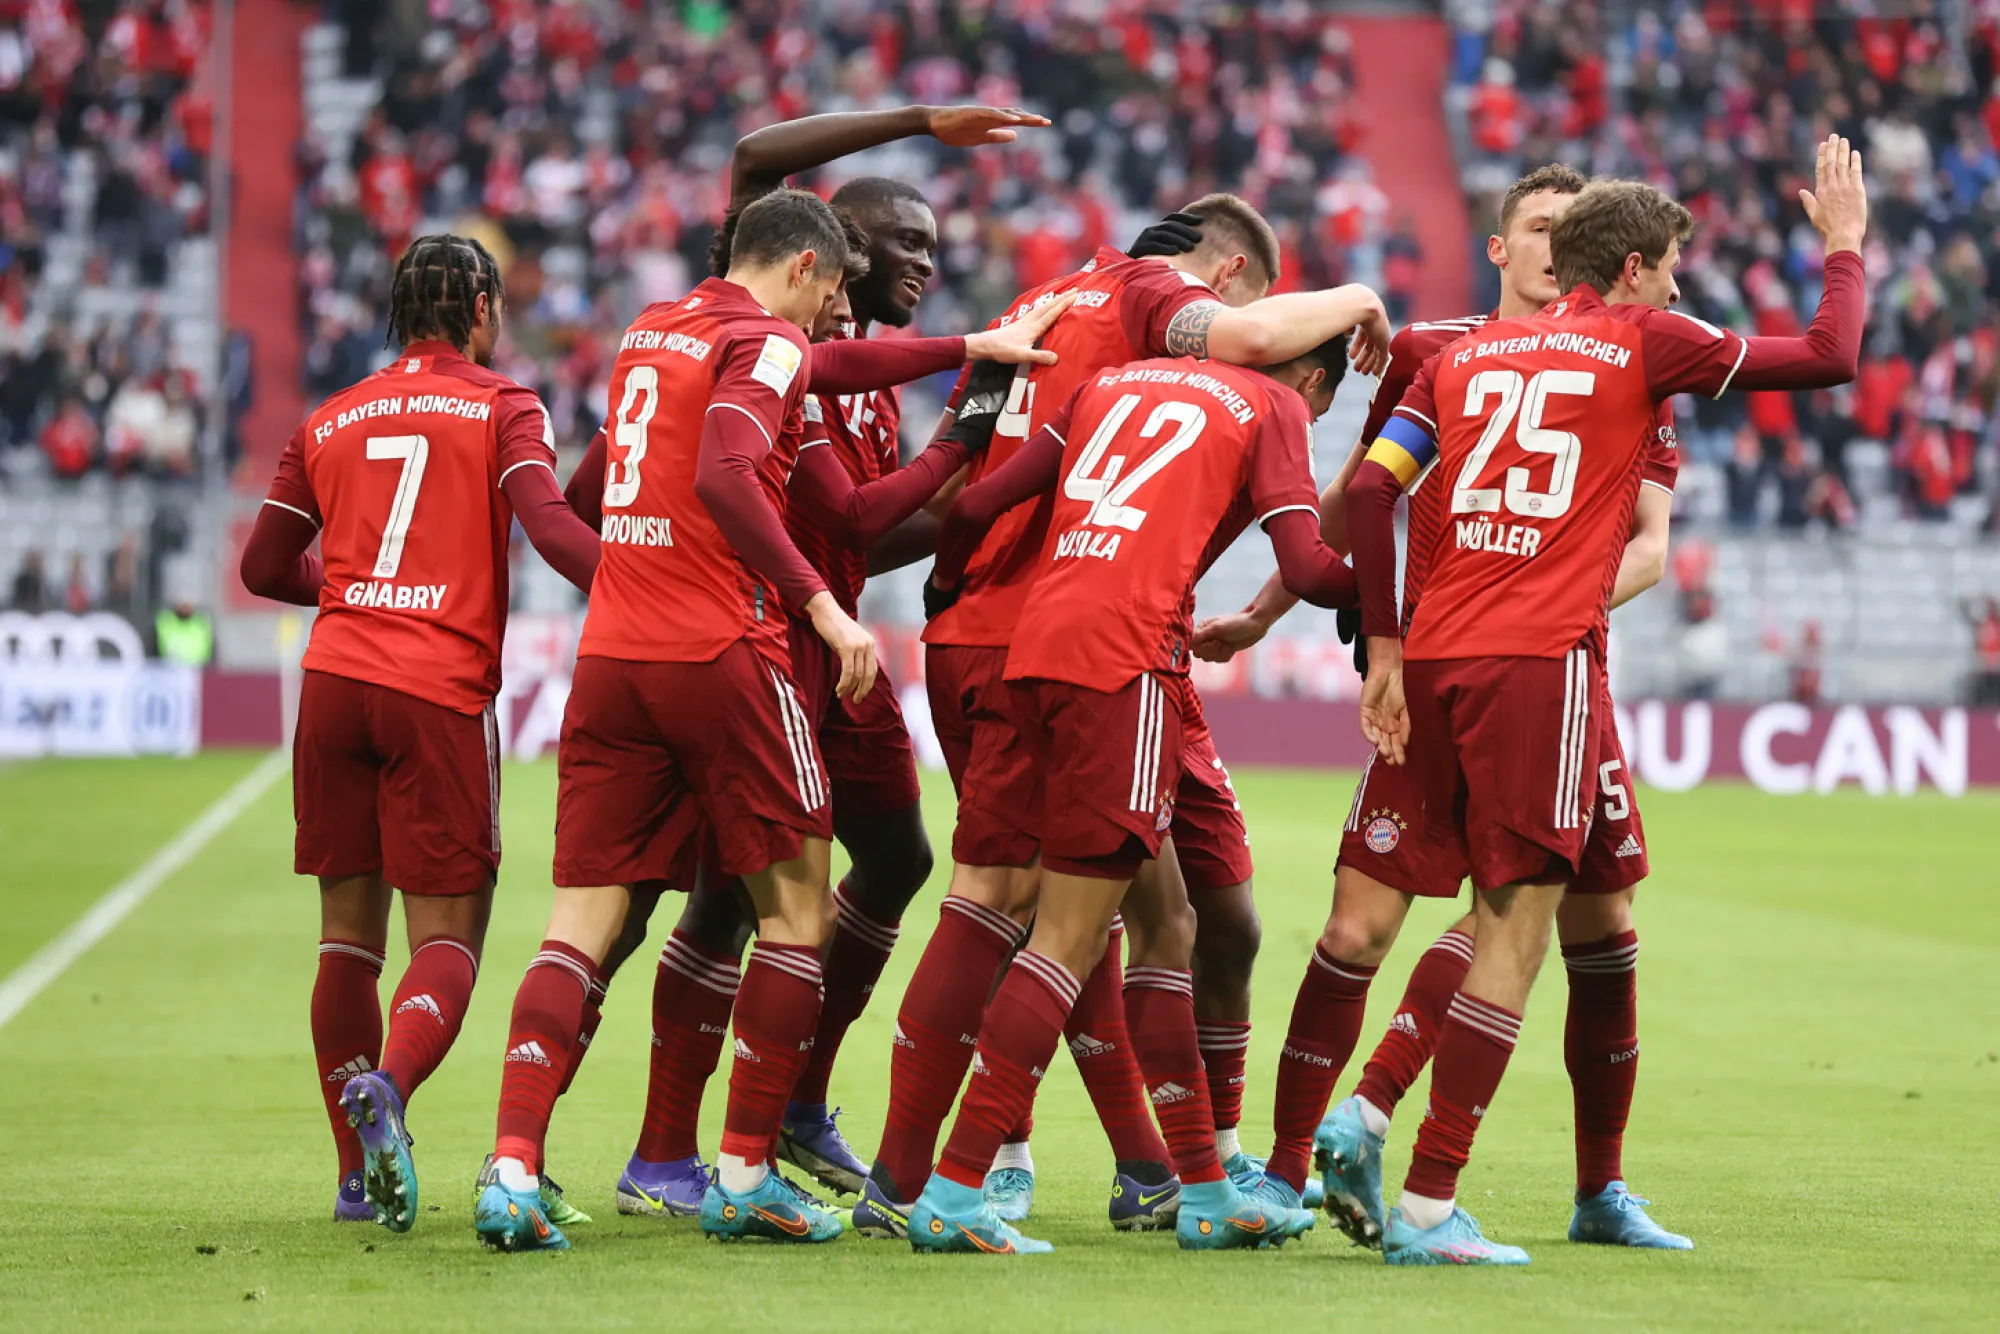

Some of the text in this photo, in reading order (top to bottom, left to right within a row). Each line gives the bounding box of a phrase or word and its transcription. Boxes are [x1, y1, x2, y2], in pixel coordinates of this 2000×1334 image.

[1453, 347, 1473, 368] FC
[1475, 333, 1542, 358] BAYERN
[1097, 374, 1121, 387] FC
[1119, 369, 1186, 384] BAYERN
[314, 420, 334, 445] FC
[337, 397, 402, 429] BAYERN
[603, 366, 659, 507] 9
[1064, 394, 1207, 532] 42
[1450, 370, 1597, 519] 25
[366, 434, 430, 578] 7
[1455, 515, 1541, 557] MÜLLER
[344, 580, 448, 610] GNABRY
[1738, 702, 1970, 798] CAN
[1599, 759, 1630, 821] 5
[1610, 846, 1643, 858] adidas
[396, 1001, 445, 1026] adidas
[505, 1053, 552, 1068] adidas
[1151, 1090, 1196, 1105] adidas
